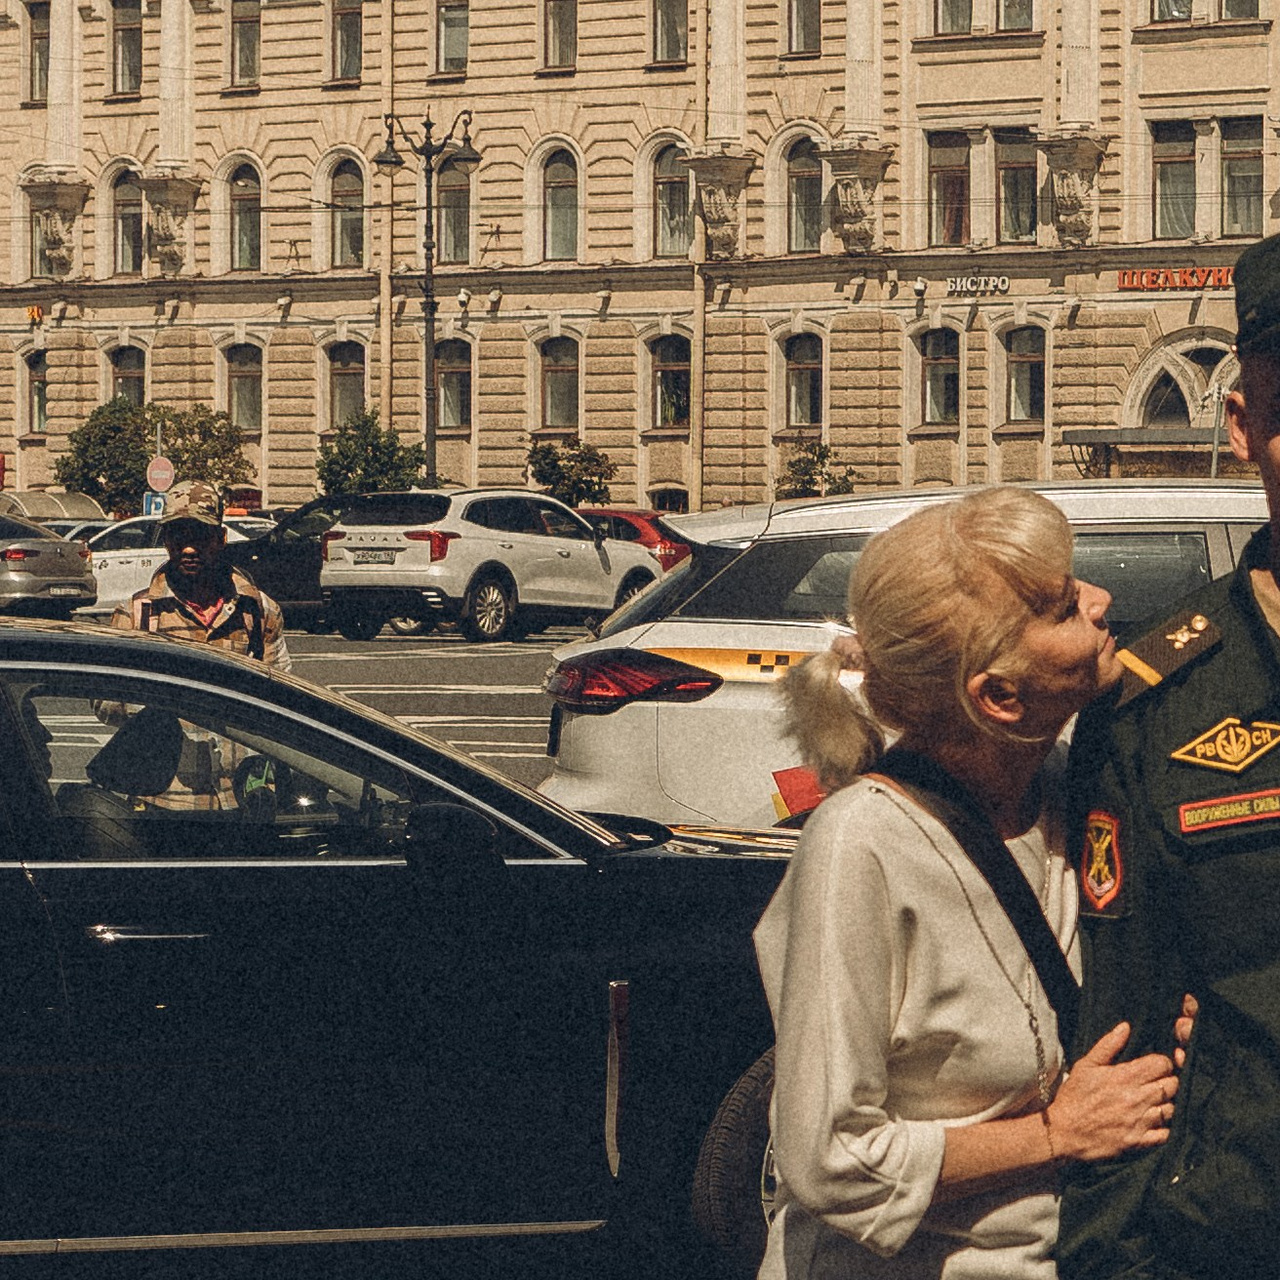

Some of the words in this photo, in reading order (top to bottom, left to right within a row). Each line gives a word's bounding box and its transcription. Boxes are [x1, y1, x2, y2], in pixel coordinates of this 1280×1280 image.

[946, 276, 1010, 292] БИСТРО
[1117, 266, 1235, 288] ЩЕЛКУН
[1195, 742, 1217, 758] РВ
[1252, 729, 1272, 745] СН
[1253, 796, 1280, 813] СИЛЫ
